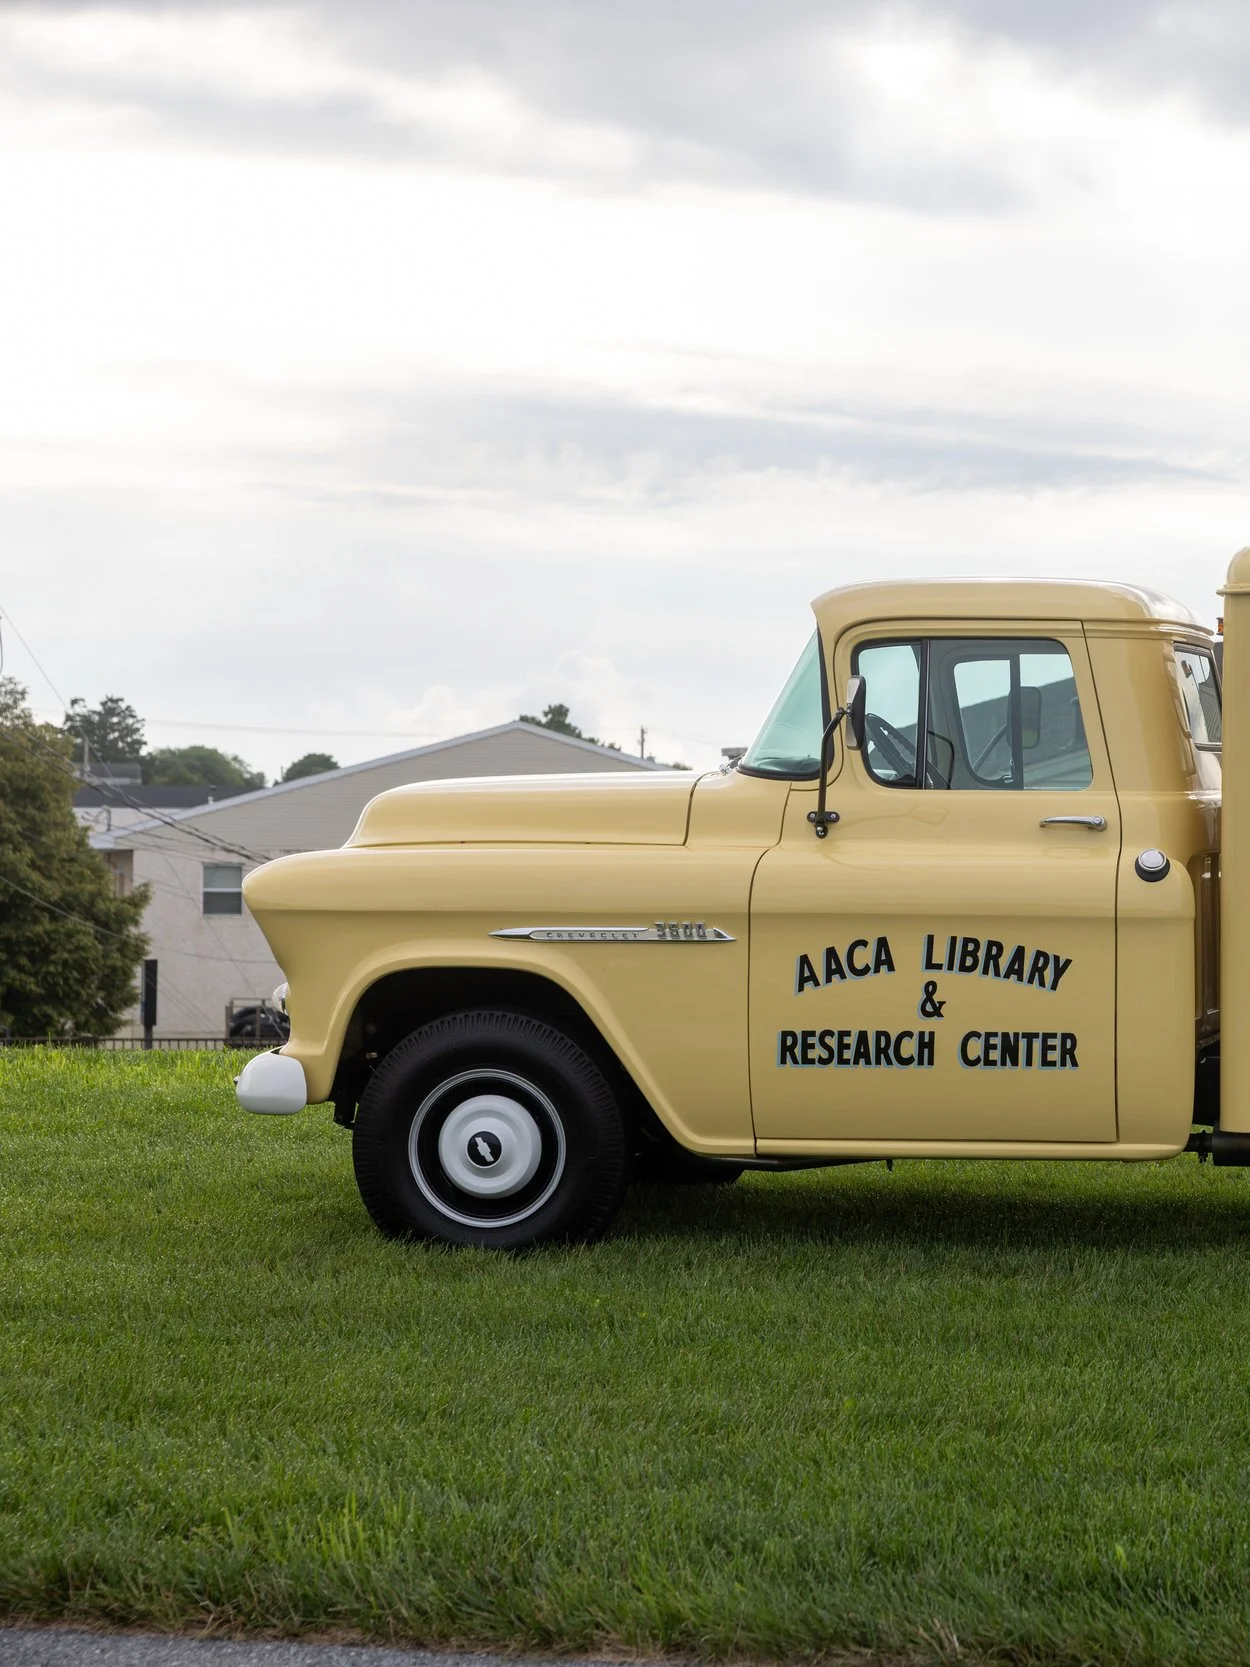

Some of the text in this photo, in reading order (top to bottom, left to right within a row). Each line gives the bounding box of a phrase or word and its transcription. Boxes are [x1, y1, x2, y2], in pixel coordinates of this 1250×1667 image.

[654, 920, 707, 939] 3600
[794, 934, 1072, 996] AACA LIBRARY
[918, 980, 946, 1020] &
[776, 1029, 1079, 1070] RESEARCH CENTER
